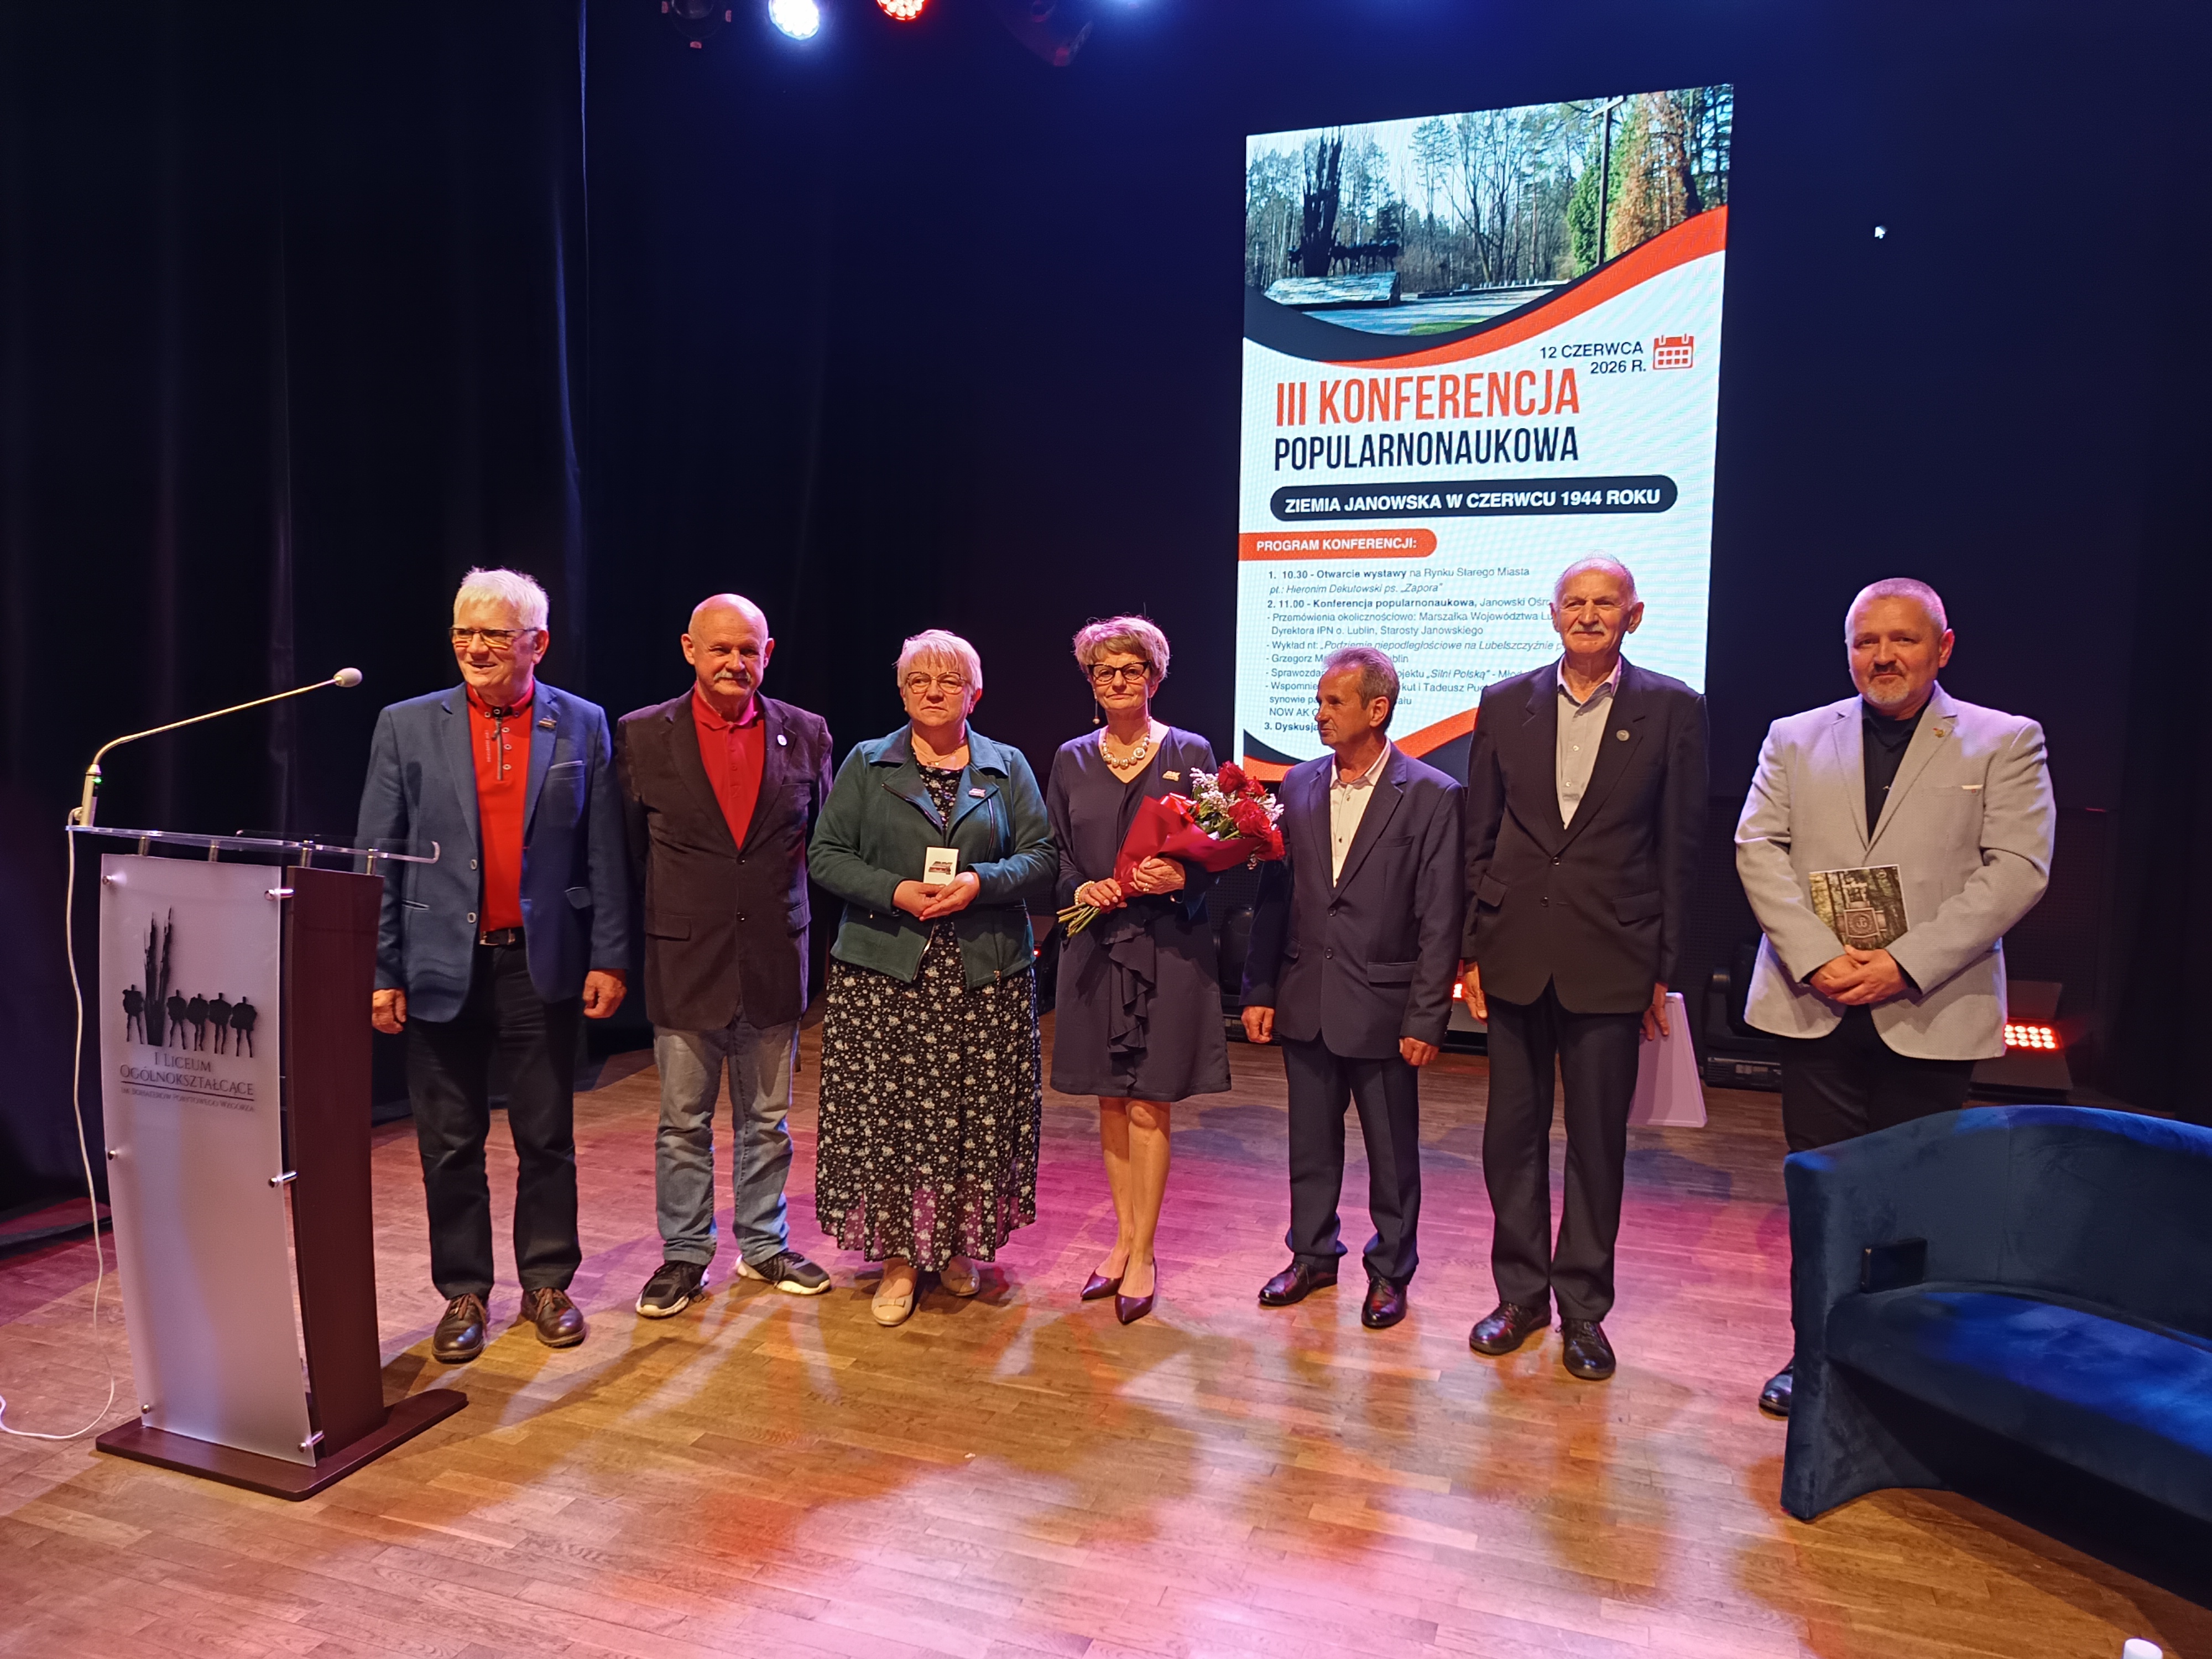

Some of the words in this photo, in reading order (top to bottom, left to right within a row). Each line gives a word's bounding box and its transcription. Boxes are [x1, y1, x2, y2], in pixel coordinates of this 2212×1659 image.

[1540, 347, 1557, 359] 12
[1562, 341, 1643, 357] CZERWCA
[1590, 360, 1626, 374] 2026
[1631, 359, 1646, 373] R.
[1276, 382, 1307, 426] III
[1319, 368, 1580, 424] KONFERENCJA
[1275, 426, 1578, 471] POPULARNONAUKOWA
[1285, 497, 1341, 514] ZIEMIA
[1344, 494, 1442, 512] JANOWSKA
[1446, 493, 1464, 509] W
[1466, 491, 1557, 508] CZERWCU
[1561, 491, 1602, 506] 1944
[1606, 488, 1660, 504] ROKU
[1256, 540, 1319, 551] PROGRAM
[1323, 538, 1417, 550] KONFERENCJI:
[1282, 570, 1308, 578] 10.30
[1317, 570, 1360, 578] Otwarcie
[1364, 570, 1406, 580] wystawy
[1424, 568, 1454, 579] Rynku
[1457, 567, 1495, 578] Starego
[1498, 567, 1530, 576] Miasta
[1286, 585, 1326, 593] Hieronim
[1329, 584, 1382, 593] Dekutowski
[1384, 586, 1398, 594] ps.
[1313, 599, 1373, 609] Konferencja
[1376, 598, 1477, 609] popularnonaukowa,
[1480, 598, 1525, 608] Janowski
[1528, 597, 1551, 606] Ośro
[1273, 613, 1335, 622] Przemówienia
[1338, 612, 1416, 621] okolicznościowe:
[1419, 612, 1468, 620] Marszałka
[1470, 612, 1538, 622] Województwa
[1272, 627, 1314, 637] Dyrektora
[1347, 626, 1378, 635] Lublin,
[1380, 625, 1418, 636] Starosty
[1421, 627, 1483, 636] Janowskiego
[1272, 641, 1305, 650] Wykład
[1374, 640, 1461, 651] niepodległościowe
[1479, 640, 1553, 651] Lubelszczyźnie
[1272, 654, 1312, 664] Grzegorz
[1397, 669, 1424, 679] ojektu
[1271, 681, 1318, 691] Wspomnie
[1402, 682, 1416, 691] kut
[1423, 682, 1464, 691] Tadeusz
[1270, 695, 1306, 704] synowie
[1270, 708, 1295, 716] NOW
[1275, 722, 1318, 731] Dyskusja
[164, 1053, 211, 1072] LICEUM
[120, 1065, 253, 1095] OGÓLNOKSZTAŁCĄCE
